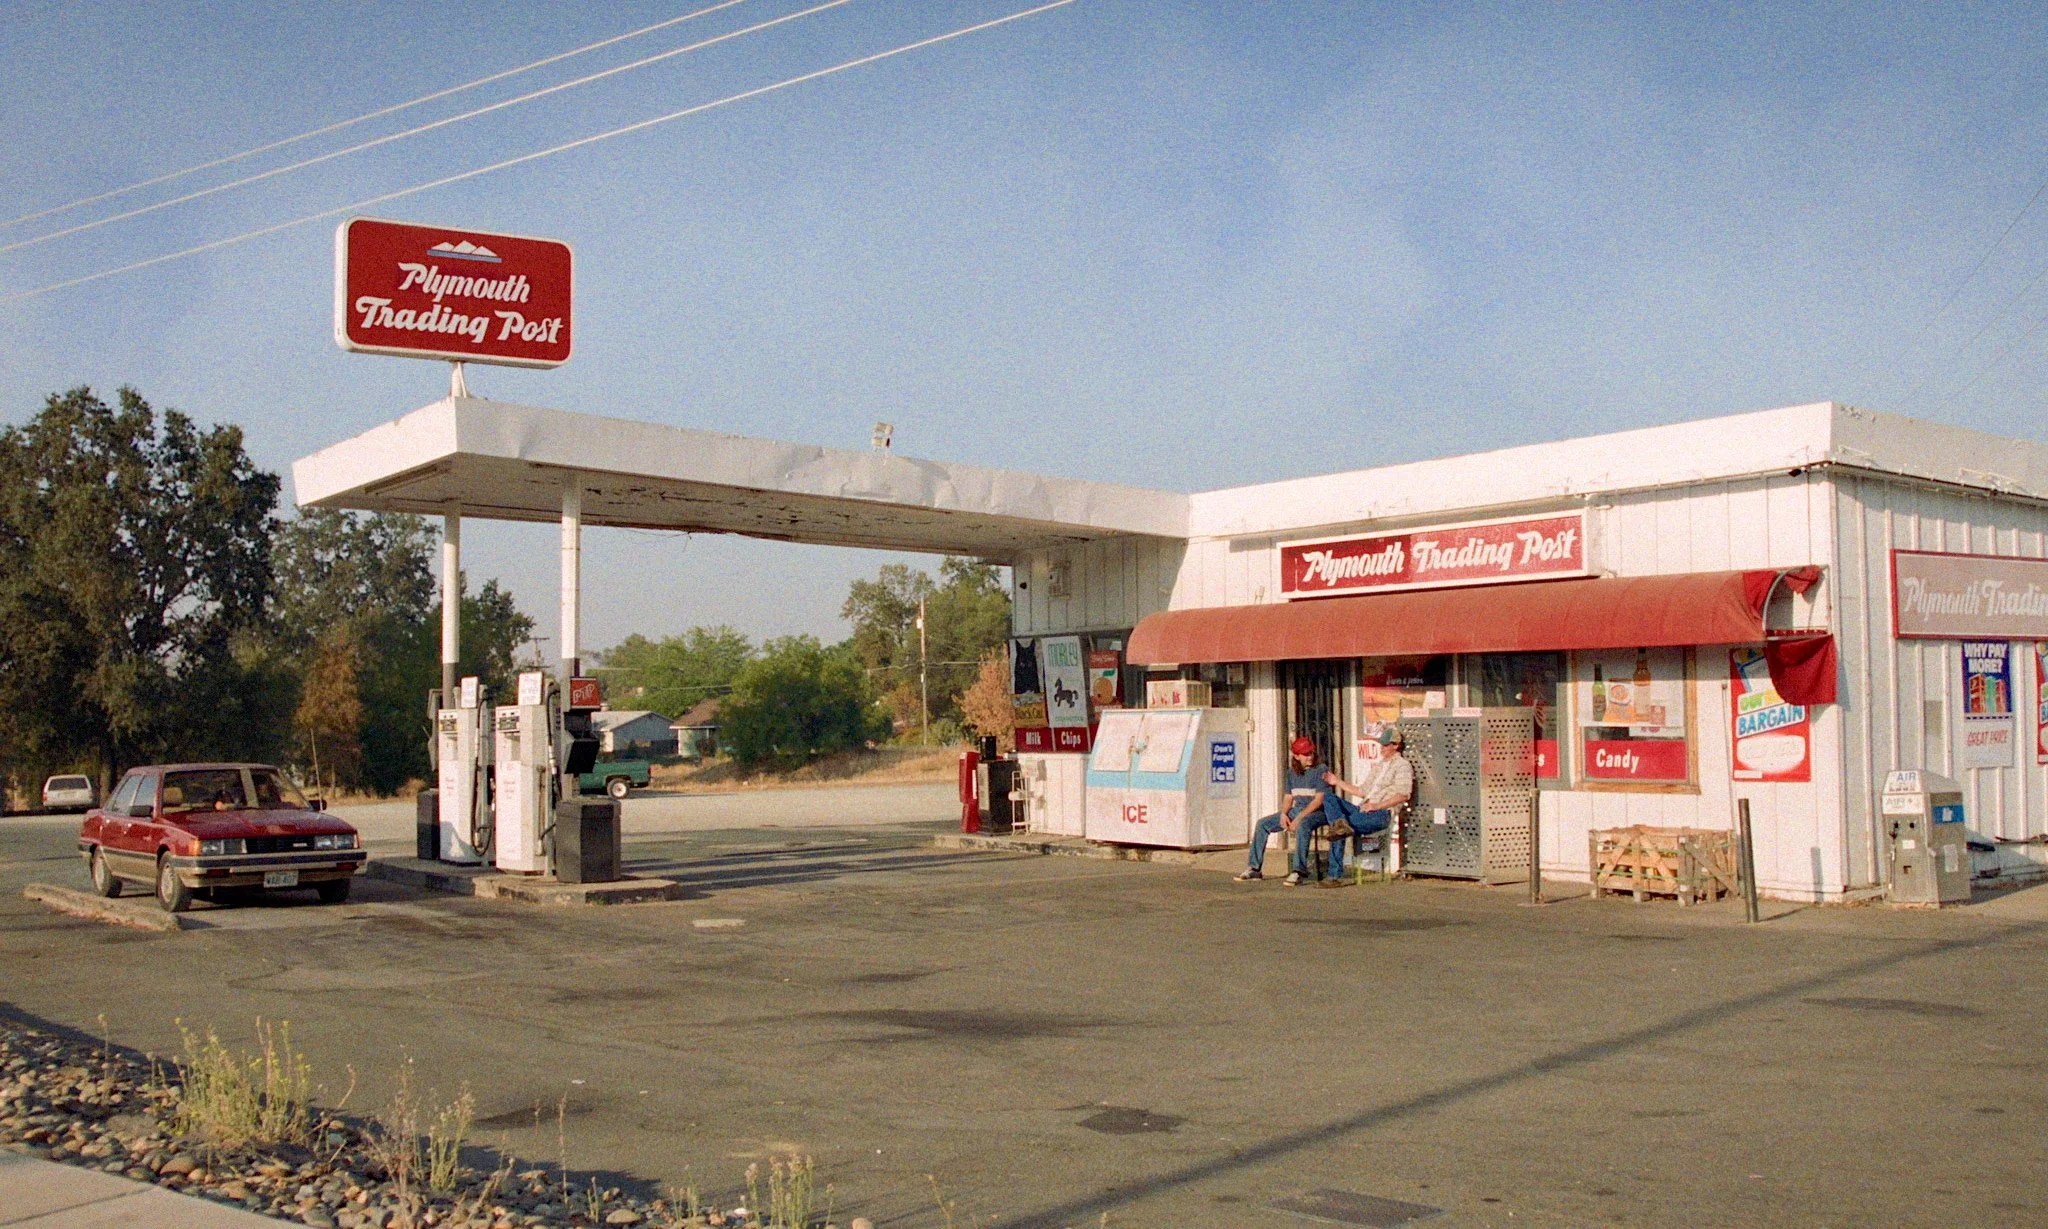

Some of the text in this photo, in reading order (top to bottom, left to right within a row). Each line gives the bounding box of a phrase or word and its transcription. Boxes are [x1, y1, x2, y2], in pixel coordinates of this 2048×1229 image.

[398, 262, 531, 303] Plymouth
[355, 295, 564, 344] Trading Post
[1302, 529, 1579, 586] Plymouth Trading Post
[1902, 576, 1980, 623] Plymouth
[1963, 642, 2008, 659] WHY PAY
[1738, 705, 1803, 736] BARGAIN
[1025, 731, 1042, 746] Milk
[1060, 731, 1082, 748] Chips
[1212, 753, 1235, 762] Forget
[1213, 744, 1233, 753] Don't
[1595, 748, 1640, 774] Candy
[1211, 767, 1235, 781] ICE
[1896, 772, 1917, 781] AIR
[1122, 804, 1148, 824] ICE
